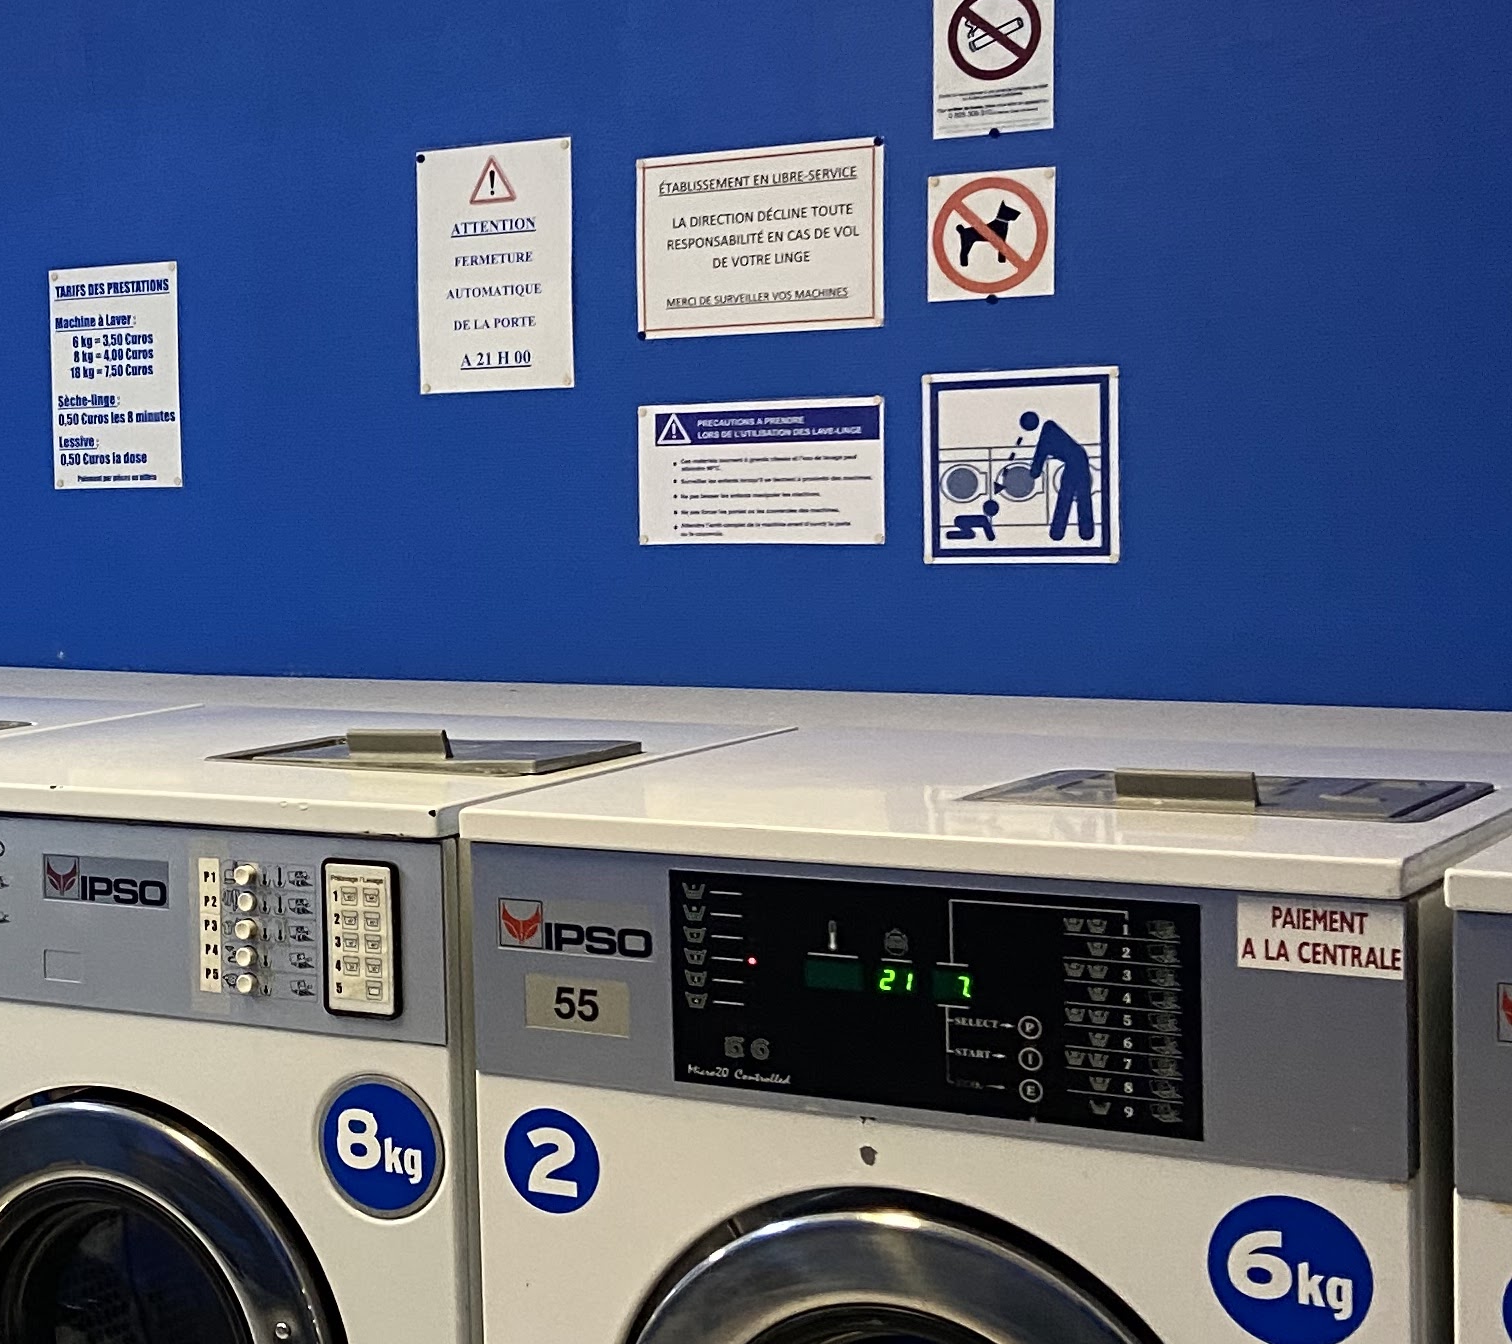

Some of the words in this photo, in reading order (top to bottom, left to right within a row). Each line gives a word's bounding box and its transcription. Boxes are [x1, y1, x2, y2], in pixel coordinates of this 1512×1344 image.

[659, 174, 749, 195] ÉTABLISSEMENT
[753, 173, 769, 186] EN
[772, 165, 857, 184] LIBRE-SERVICE
[672, 217, 686, 229] LA
[689, 212, 754, 228] DIRECTION
[757, 207, 808, 222] DÉCLINE
[811, 203, 853, 217] TOUTE
[451, 217, 536, 236] ATTENTION
[667, 231, 764, 251] RESPONSABILITÉ
[768, 231, 783, 244] EN
[787, 228, 810, 242] CAS
[814, 227, 830, 239] DE
[833, 225, 859, 238] VOL
[454, 251, 533, 267] FERMETURE
[712, 257, 728, 269] DE
[731, 253, 771, 268] VOTRE
[774, 250, 810, 265] LINGE
[55, 284, 86, 298] TARIFS
[88, 283, 105, 295] DES
[107, 278, 169, 295] PRESTATIONS
[446, 283, 542, 300] AUTOMATIQUE
[667, 296, 697, 308] MERCI
[699, 295, 712, 306] DE
[714, 292, 769, 305] SURVEILLER
[772, 290, 792, 301] VOS
[794, 287, 848, 300] MACHINES
[55, 316, 96, 329] Machine
[98, 314, 104, 327] à
[453, 319, 470, 331] DE
[474, 318, 490, 330] LA
[493, 316, 536, 329] PORTE
[72, 336, 79, 348] 6
[81, 336, 93, 348] kg
[102, 334, 123, 347] 3,50
[74, 351, 80, 363] 8
[82, 351, 93, 364] kg
[461, 354, 474, 367] A
[477, 352, 492, 366] 21
[498, 351, 509, 365] H
[514, 350, 531, 365] 00
[70, 366, 81, 379] 18
[82, 366, 94, 379] kg
[105, 364, 124, 378] 7,50
[58, 413, 79, 426] 0,50
[111, 412, 125, 423] les
[127, 411, 133, 423] 8
[136, 410, 176, 423] minutes
[697, 417, 755, 428] PRECAUTIONS
[697, 430, 719, 440] LORS
[721, 430, 732, 439] DE
[60, 453, 81, 466] 0,50
[112, 452, 121, 464] la
[123, 452, 147, 464] dose
[203, 871, 216, 883] P1
[80, 875, 168, 907] IPSO
[333, 891, 338, 901] 1
[204, 896, 217, 907] P2
[204, 919, 218, 931] P3
[334, 913, 340, 925] 2
[1271, 906, 1369, 935] PAIEMENT
[1123, 924, 1129, 935] 1
[335, 936, 341, 947] 3
[544, 922, 653, 958] IPSO
[205, 944, 218, 955] P4
[1121, 947, 1131, 958] 2
[1241, 937, 1256, 959] A
[1264, 939, 1290, 962] LA
[1298, 942, 1402, 971] CENTRALE
[335, 960, 342, 971] 4
[205, 968, 219, 980] P5
[879, 969, 914, 991] 21
[1122, 969, 1132, 981] 3
[336, 982, 343, 993] 5
[553, 986, 599, 1022] 55
[1122, 992, 1132, 1004] 4
[954, 1016, 1000, 1029] SELECT
[1123, 1014, 1133, 1026] 5
[1123, 1037, 1133, 1049] 6
[954, 1048, 991, 1059] START
[1123, 1058, 1133, 1070] 7
[734, 1069, 791, 1085] Controlled
[1123, 1081, 1134, 1093] 8
[1123, 1106, 1134, 1118] 9
[335, 1108, 423, 1185] 8kg
[526, 1126, 578, 1198] 2
[1227, 1229, 1353, 1320] 6kg
